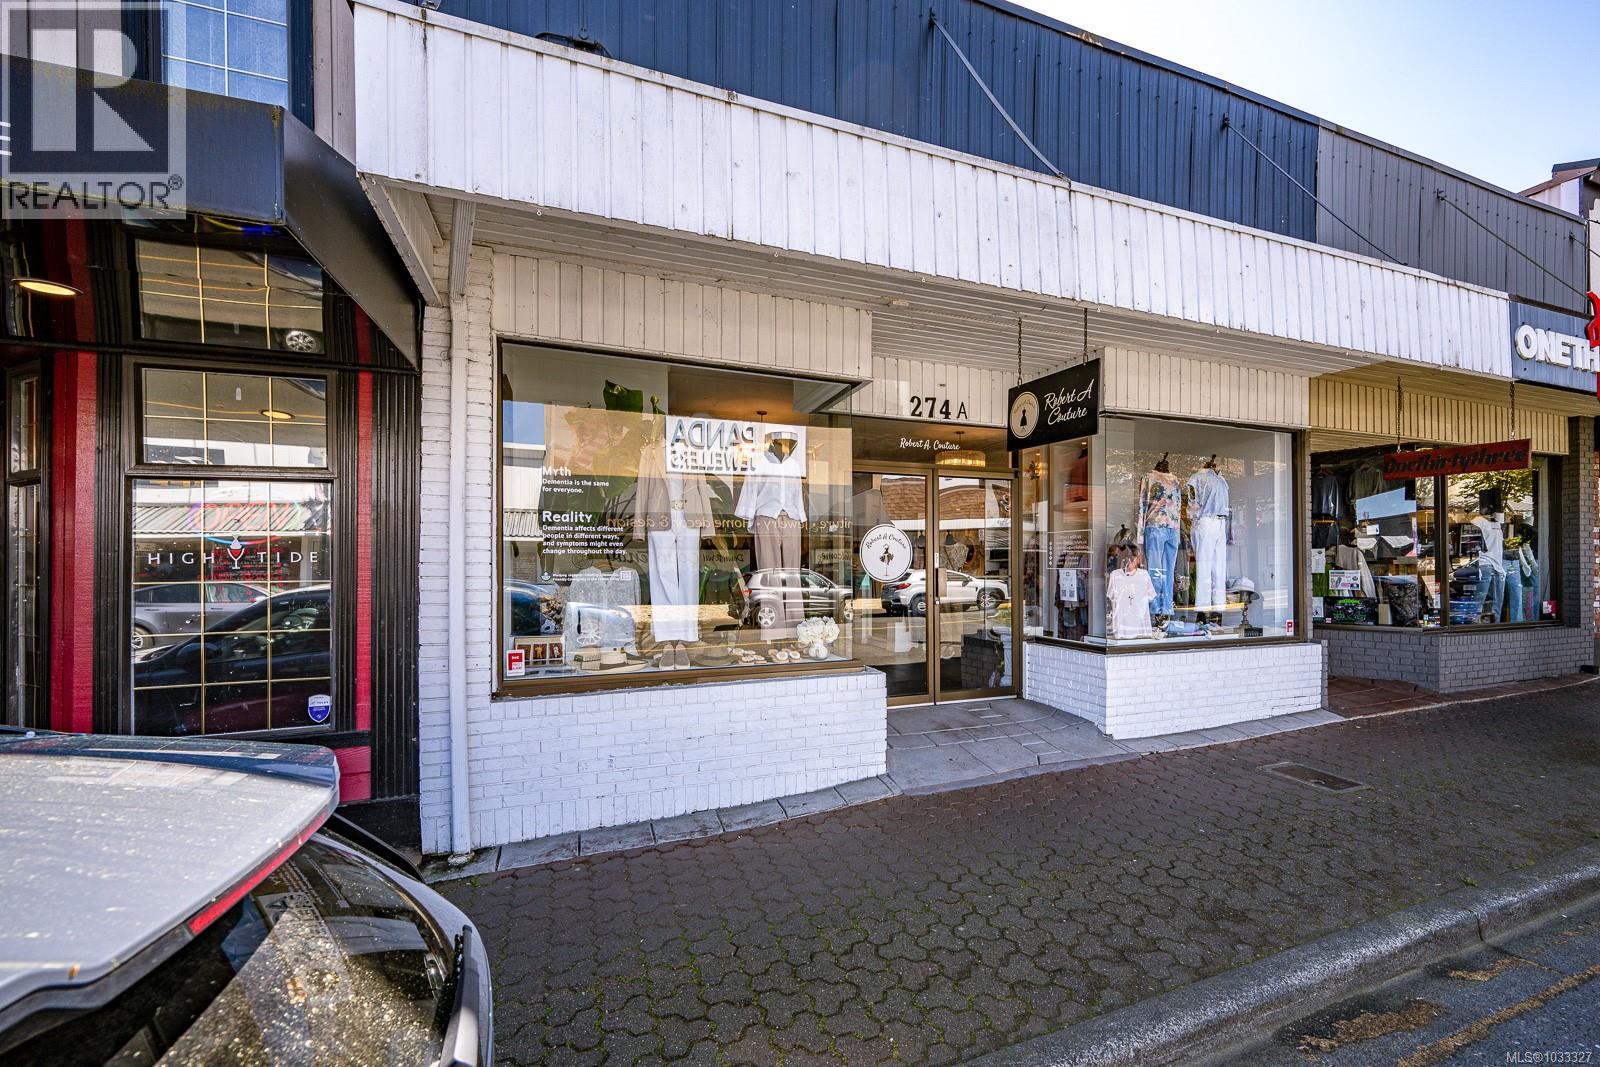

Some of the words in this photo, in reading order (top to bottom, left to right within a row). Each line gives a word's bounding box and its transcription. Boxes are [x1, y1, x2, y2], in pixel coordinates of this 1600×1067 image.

[1043, 387, 1077, 411] Robert
[1076, 378, 1095, 402] A
[909, 395, 951, 419] 274
[957, 401, 968, 419] A
[1047, 406, 1088, 425] Couture
[900, 437, 923, 448] Robert
[933, 439, 960, 450] Couture
[542, 465, 571, 476] Myth
[542, 510, 592, 523] Reality
[147, 552, 214, 565] HIGH
[257, 551, 318, 563] TIDE
